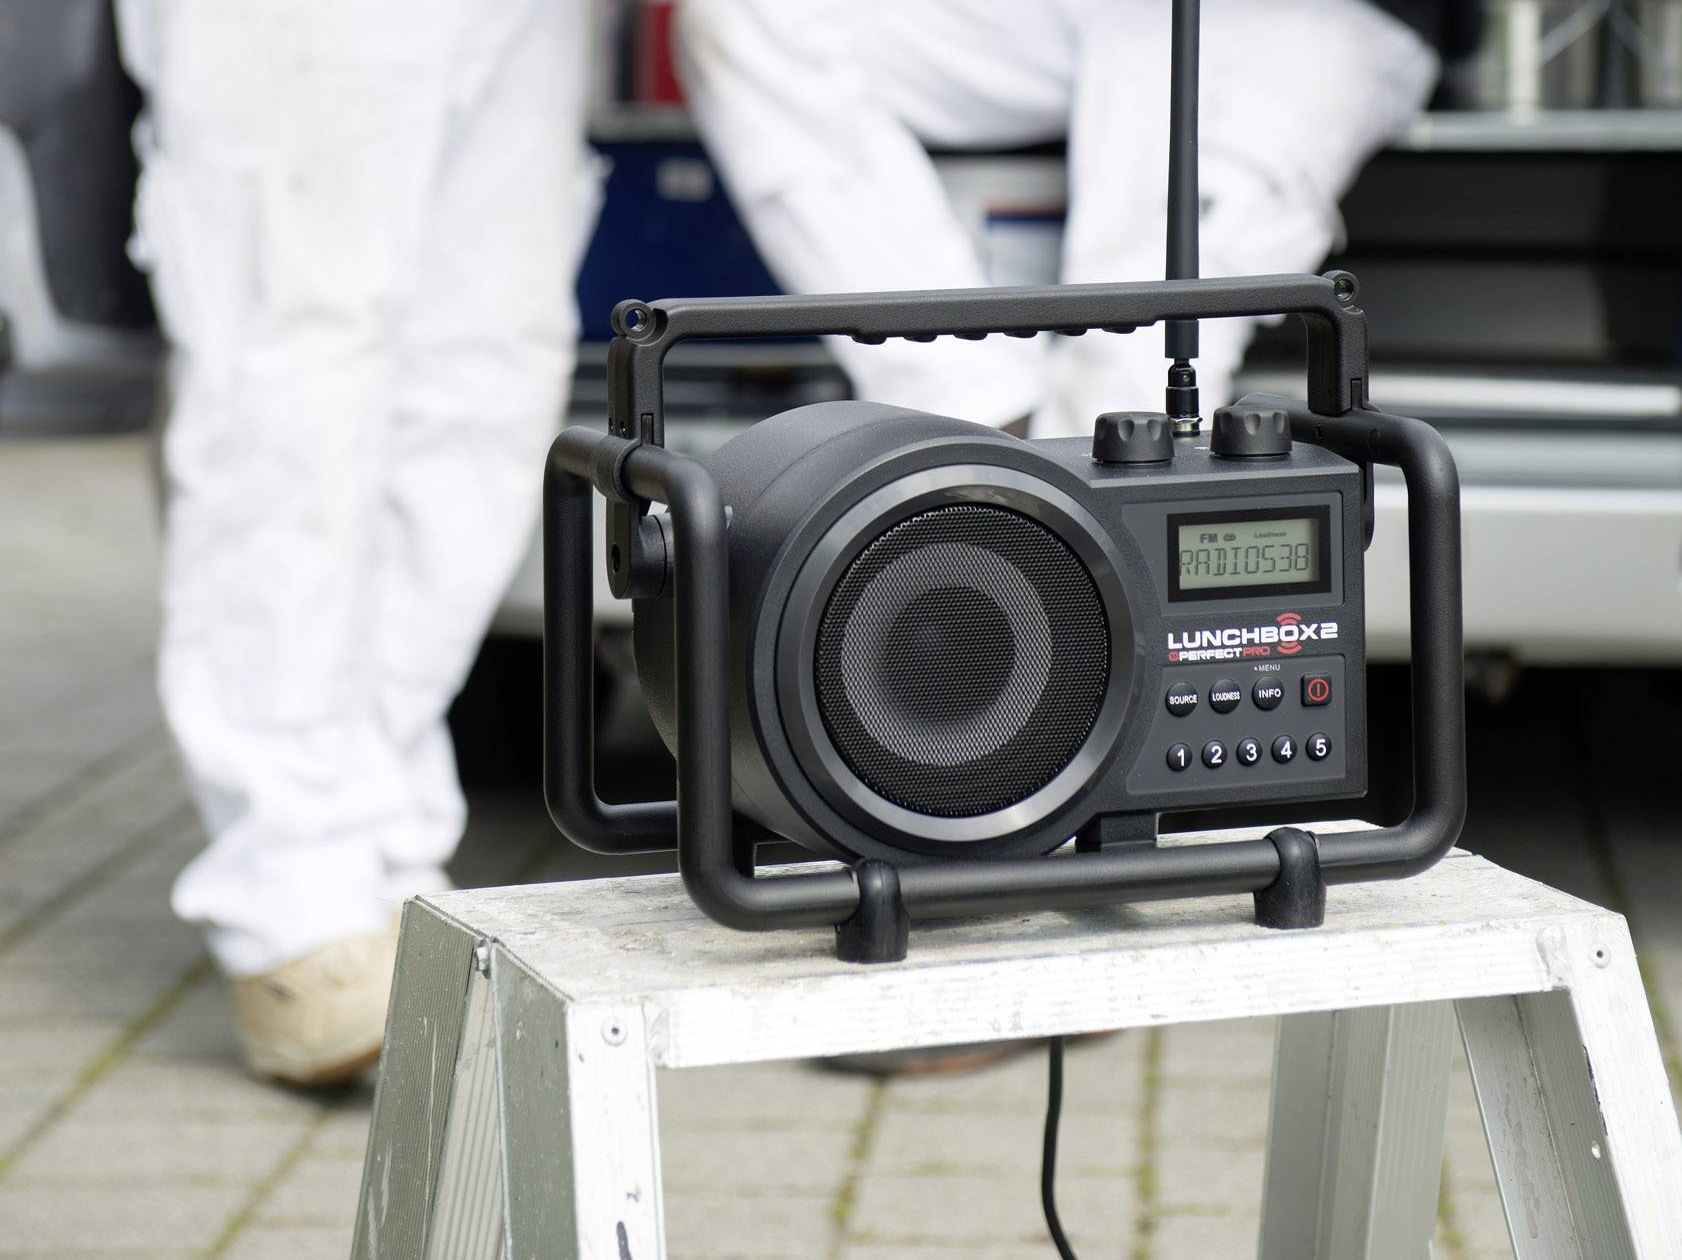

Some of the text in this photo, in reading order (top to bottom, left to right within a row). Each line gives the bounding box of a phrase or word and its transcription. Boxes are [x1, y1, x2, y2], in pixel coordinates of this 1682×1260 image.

[1200, 533, 1218, 544] FM
[1167, 622, 1339, 650] LUNCHBOX2
[1212, 691, 1241, 702] LOUDNESS
[1258, 688, 1282, 699] INFO
[1169, 694, 1198, 705] SOURCE
[1176, 739, 1327, 767] 1 2 3 4 5
